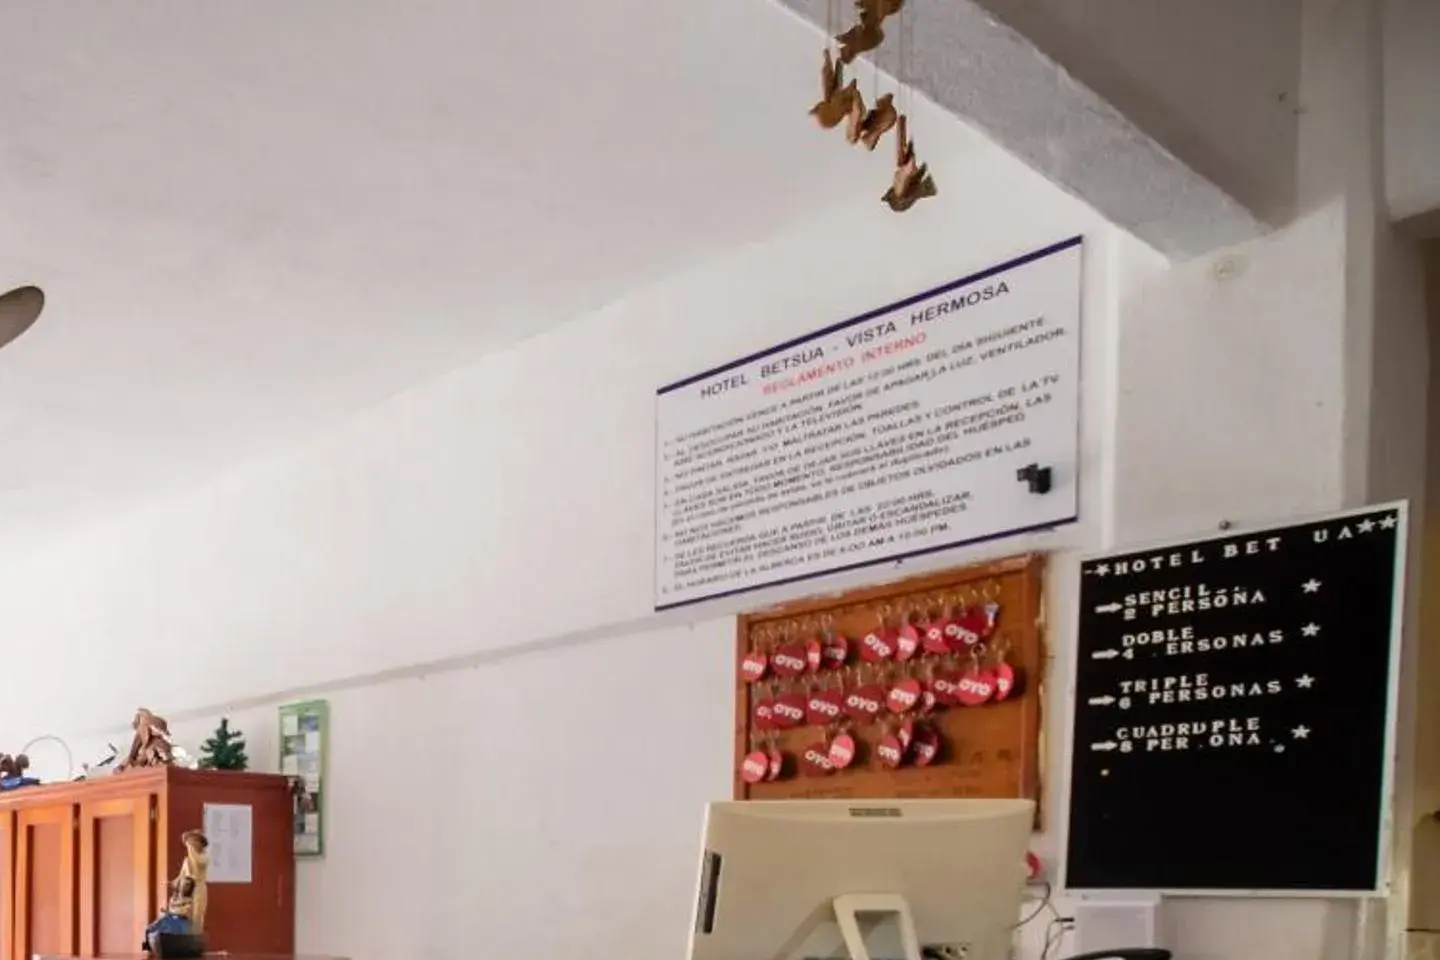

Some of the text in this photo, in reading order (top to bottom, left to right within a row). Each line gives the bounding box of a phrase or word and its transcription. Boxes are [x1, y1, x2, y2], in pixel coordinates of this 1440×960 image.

[701, 375, 748, 401] HOTEL
[846, 321, 897, 351] VISTA
[912, 282, 1009, 328] HERMOSA
[764, 331, 927, 398] REGLAMENTO INTERNO
[1114, 548, 1204, 575] HOTEL
[1123, 588, 1265, 621] 2 PERSONA
[945, 624, 978, 644] OYO
[1122, 625, 1194, 647] DOBLE
[775, 654, 805, 670] OYO
[1121, 647, 1134, 660] 4
[935, 679, 957, 694] OY
[959, 678, 991, 696] OYO
[1119, 672, 1208, 694] TRIPLE
[1148, 679, 1282, 705] PERSONAS
[774, 703, 804, 720] OYO
[810, 699, 839, 716] OYO
[847, 695, 879, 713] OYO
[1116, 716, 1260, 740] CUADRUPLE
[1119, 740, 1133, 753] 8
